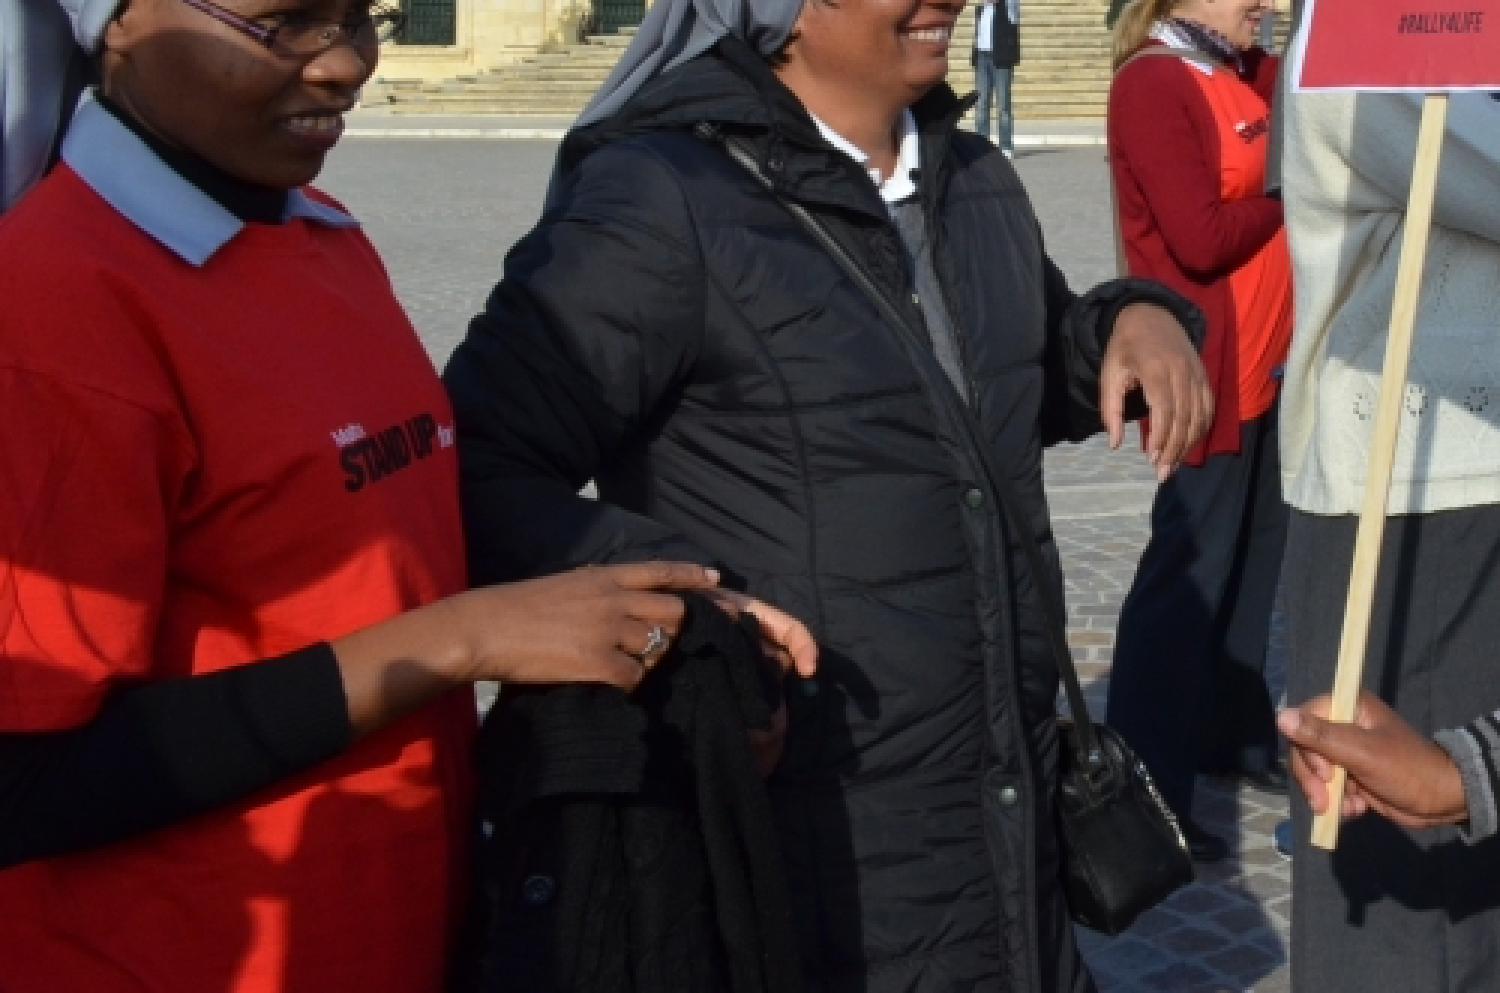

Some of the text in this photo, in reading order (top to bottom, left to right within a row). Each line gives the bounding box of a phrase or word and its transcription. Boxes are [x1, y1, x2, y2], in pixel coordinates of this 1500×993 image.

[1397, 10, 1485, 35] #RALLY4LIFE
[338, 424, 412, 493] STAND
[404, 411, 436, 460] UP
